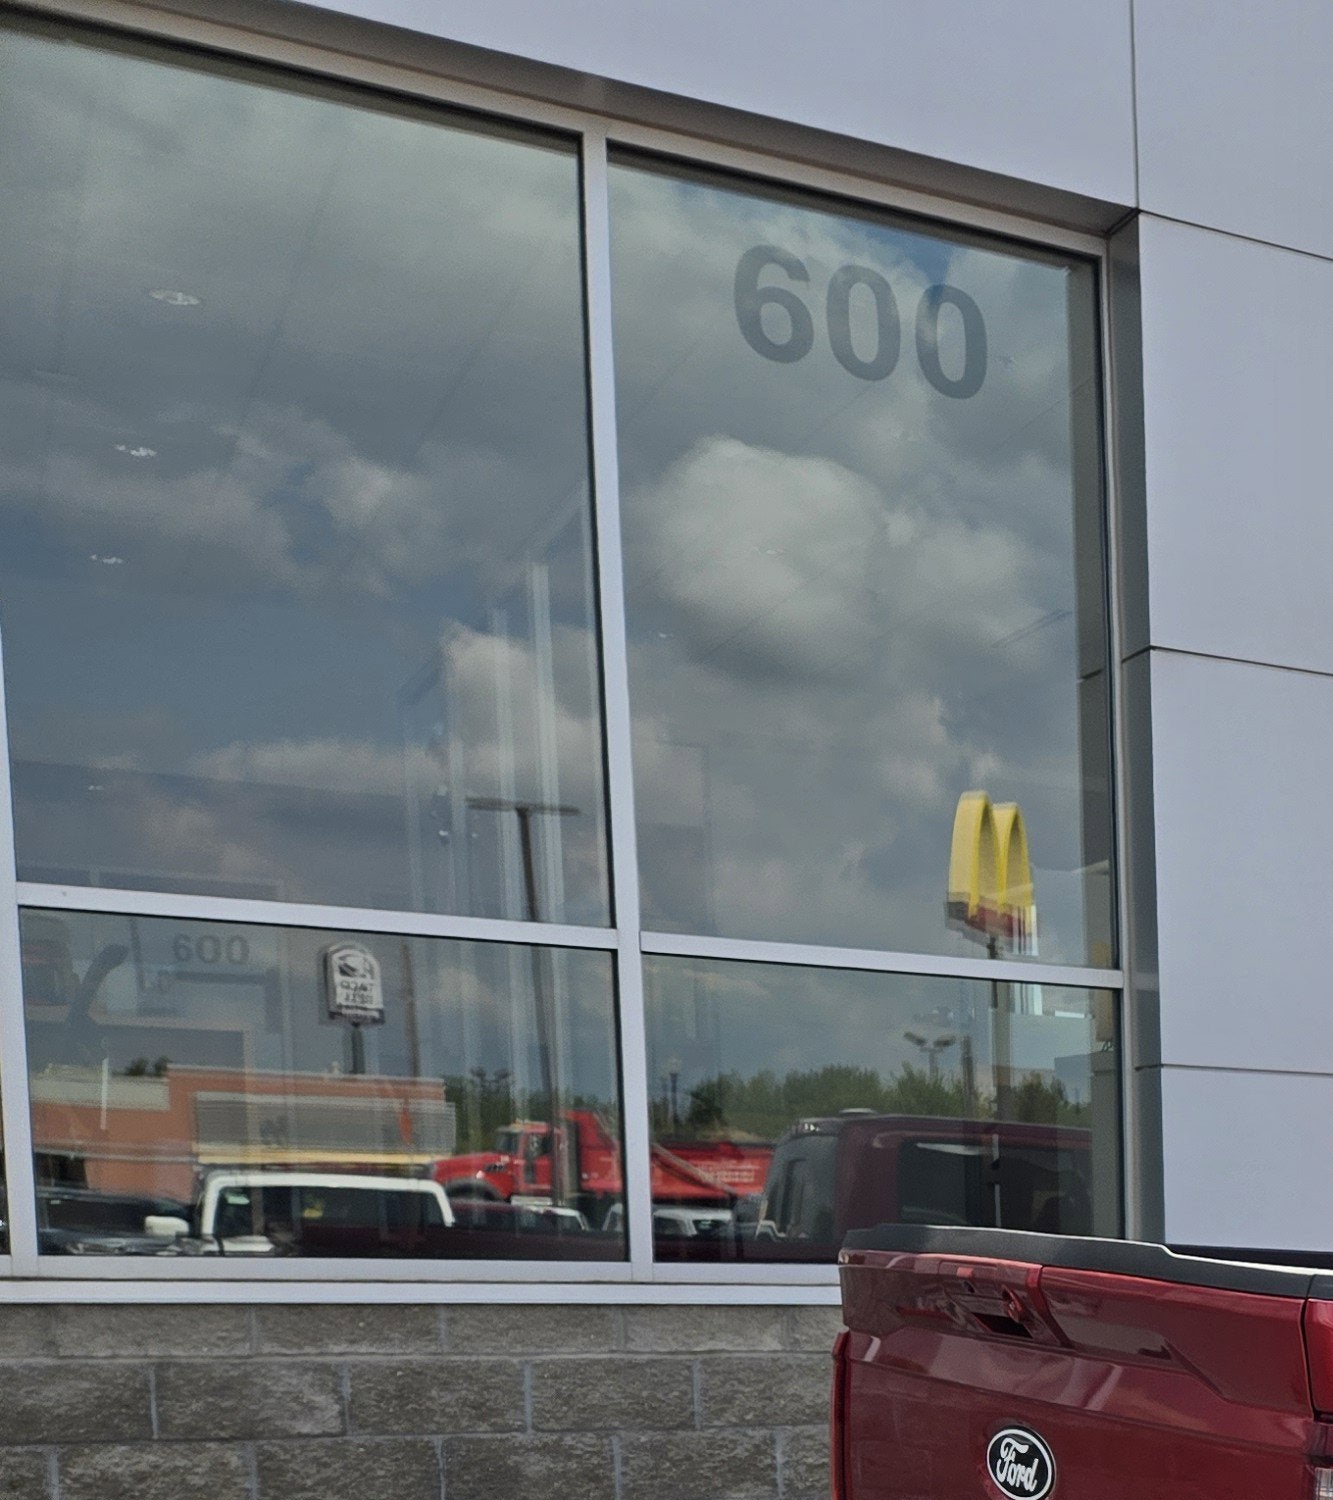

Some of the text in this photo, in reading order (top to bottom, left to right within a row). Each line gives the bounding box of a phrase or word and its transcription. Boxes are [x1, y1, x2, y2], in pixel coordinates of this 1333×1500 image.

[733, 244, 988, 400] 600
[173, 933, 249, 964] 600
[996, 1437, 1039, 1492] Ford
